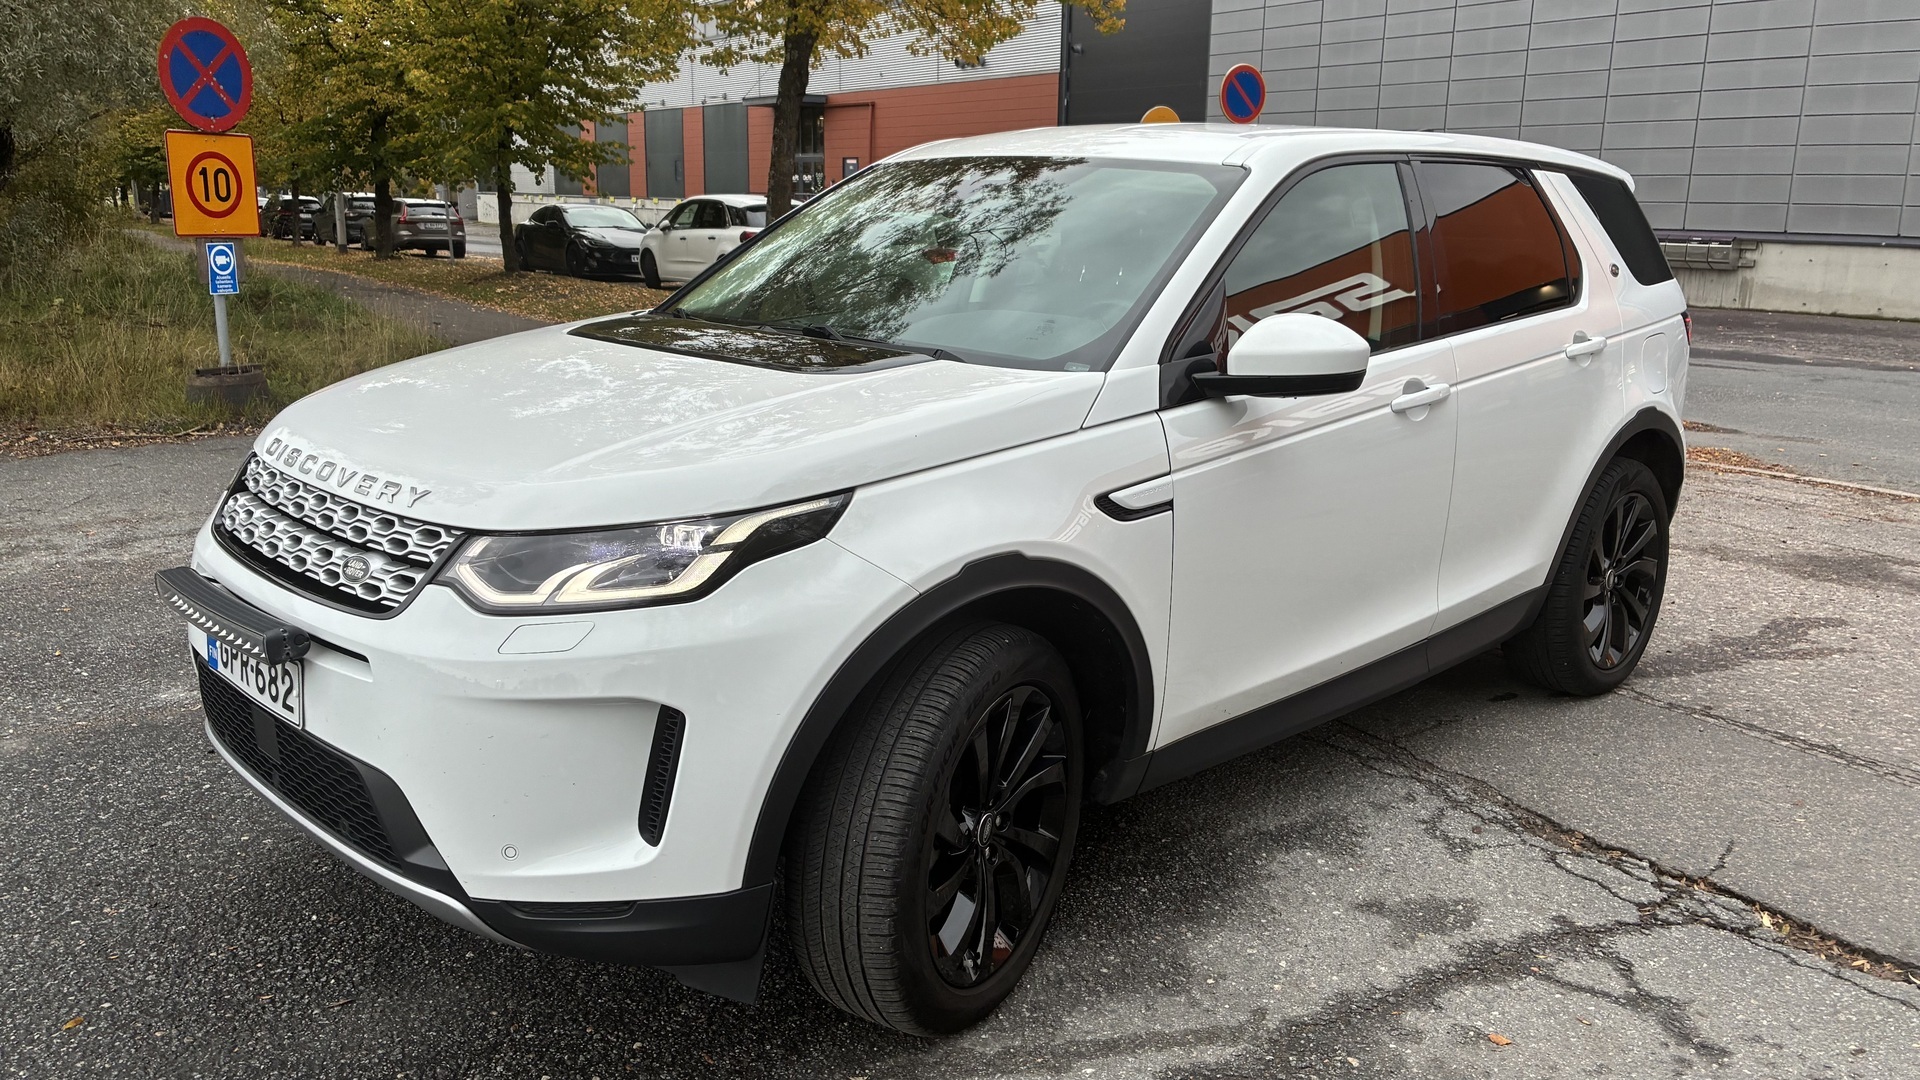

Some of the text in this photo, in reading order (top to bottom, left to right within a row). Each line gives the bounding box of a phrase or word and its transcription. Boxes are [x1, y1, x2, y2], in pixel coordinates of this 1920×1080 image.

[198, 166, 232, 203] 10
[265, 437, 432, 508] DISCOVERY
[220, 642, 295, 714] GPR-682
